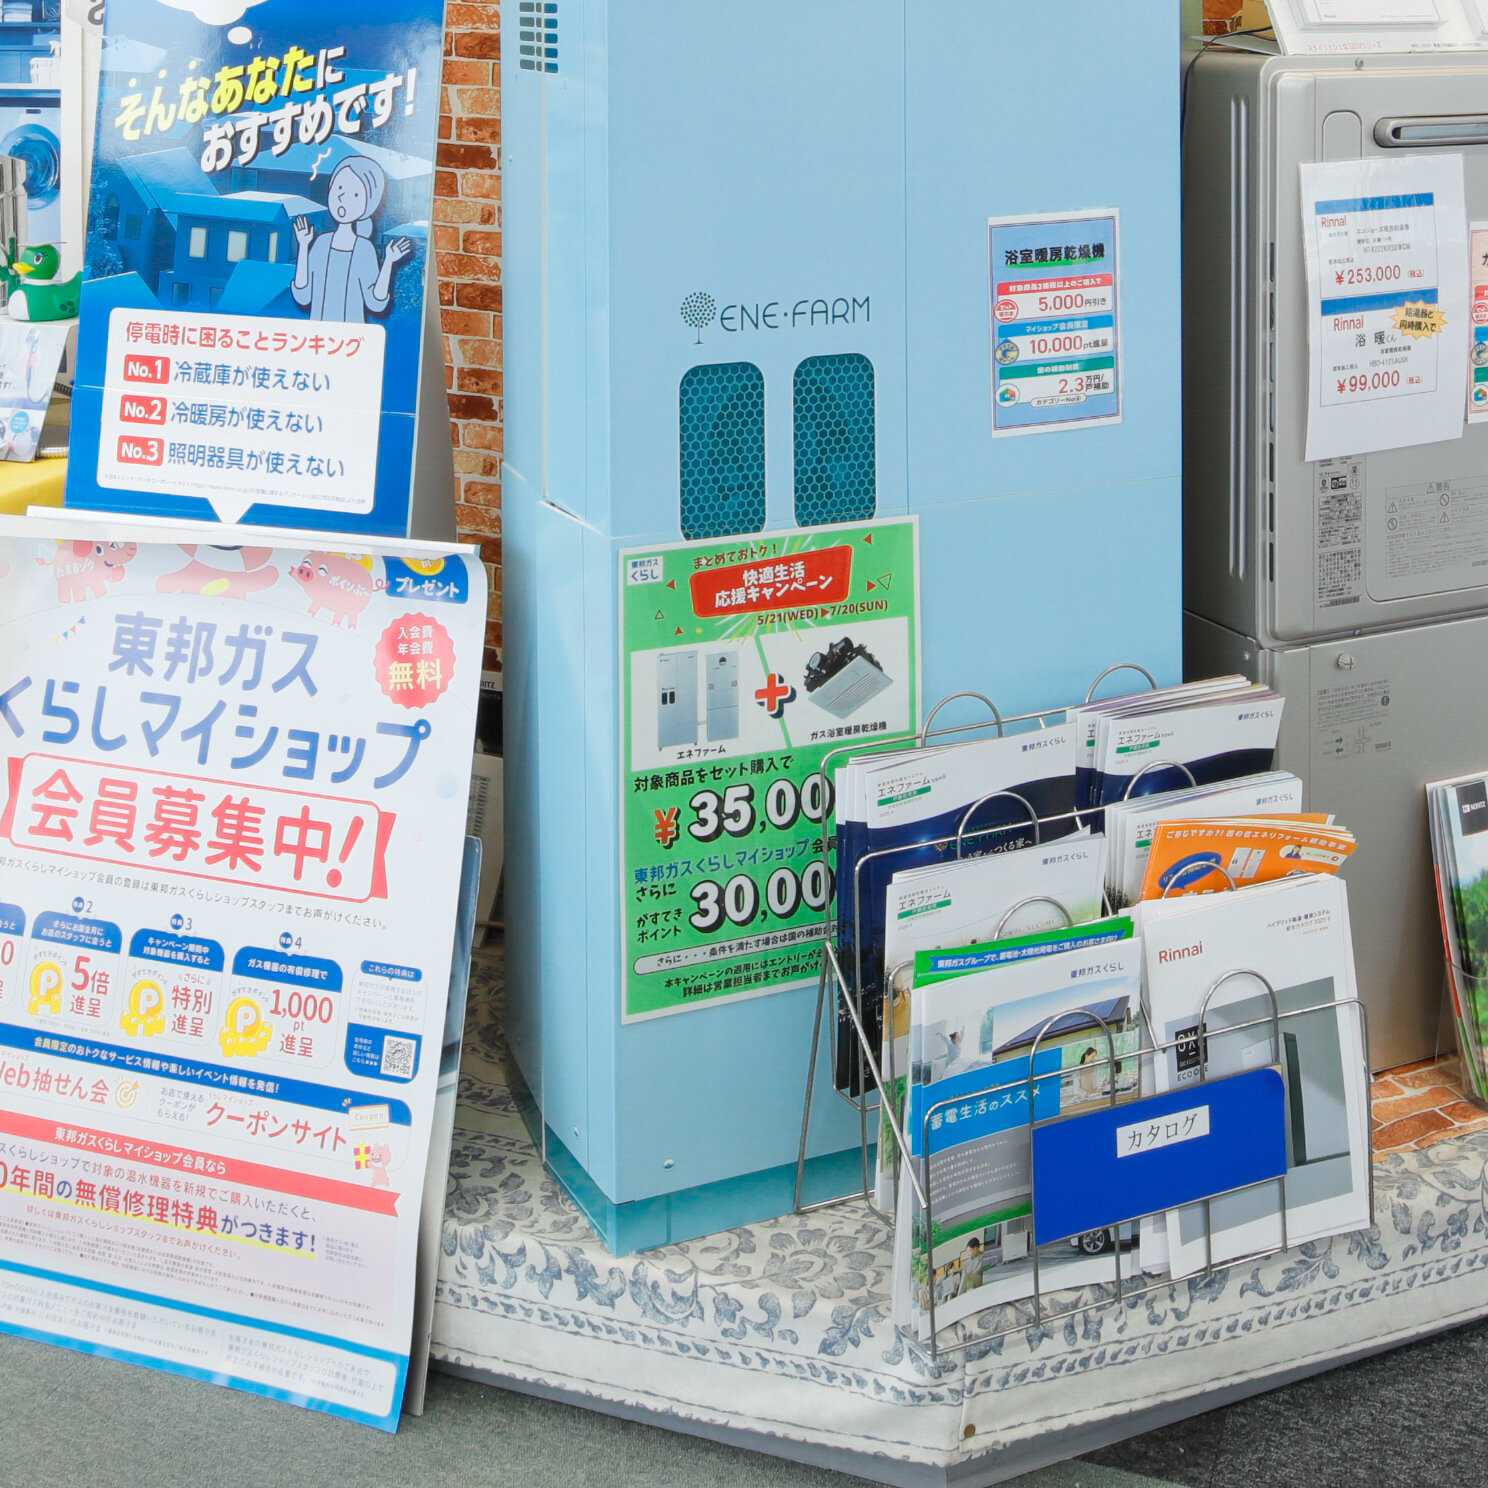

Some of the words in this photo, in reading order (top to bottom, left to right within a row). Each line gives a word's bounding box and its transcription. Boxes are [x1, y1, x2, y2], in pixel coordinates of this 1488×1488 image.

[115, 46, 347, 141] そんなあなたに
[201, 68, 417, 173] おすすめです!
[1321, 216, 1347, 228] Rinnai
[1004, 243, 1105, 266] 浴室暖房乾燥機
[1333, 316, 1364, 331] Rinnai
[1405, 307, 1435, 320] 給湯器と
[1399, 320, 1437, 332] 同時購入で
[126, 321, 365, 357] 停電時に困ることランキング
[173, 360, 330, 391] 冷蔵庫が使えない
[171, 401, 323, 433] 冷暖房が使えない
[167, 442, 344, 478] 照明器具が使えない
[630, 559, 660, 570] 東邦ガス
[630, 569, 660, 582] くらし
[742, 561, 806, 585] 快適生活
[395, 576, 460, 600] プレゼント
[714, 574, 834, 608] 応援キャンペーン
[757, 608, 819, 625] 5/21(WED)
[396, 624, 434, 641] 入会費
[108, 611, 319, 696] 東邦ガス
[396, 641, 434, 657] 年会費
[387, 661, 443, 691] 無料
[1238, 711, 1274, 721] 東邦ガスくらし
[676, 745, 727, 760] エネファーム
[1022, 736, 1067, 752] 東邦ガスくらし
[633, 755, 793, 794] 対象商品をセット購入で
[1255, 793, 1294, 806] 東邦ガスくらし
[27, 768, 365, 889] 会員募集中!
[1042, 851, 1088, 865] 東邦ガスくらし
[635, 883, 677, 901] さらに
[636, 908, 684, 929] がすてき
[637, 925, 682, 943] ポイント
[1159, 941, 1203, 965] Rinnai
[71, 956, 110, 996] 5倍
[184, 973, 204, 985] さらに
[1070, 962, 1125, 979] 東邦ガスくらし
[70, 994, 101, 1018] 進呈
[171, 985, 213, 1015] 特別
[269, 989, 334, 1024] 1,000
[171, 1015, 204, 1038] 進呈
[293, 1021, 304, 1033] pt
[279, 1033, 313, 1058] 進呈
[33, 1035, 280, 1094] 会員限定のおトクなサービス情報や楽しいイベント情報を発信!
[929, 1086, 1041, 1131] 蓄電生活のススメ
[206, 1101, 347, 1152] クーポンサイト
[1126, 1112, 1199, 1152] カタログ
[55, 1126, 227, 1175] 東邦ガスくらしマイショップ会員なら
